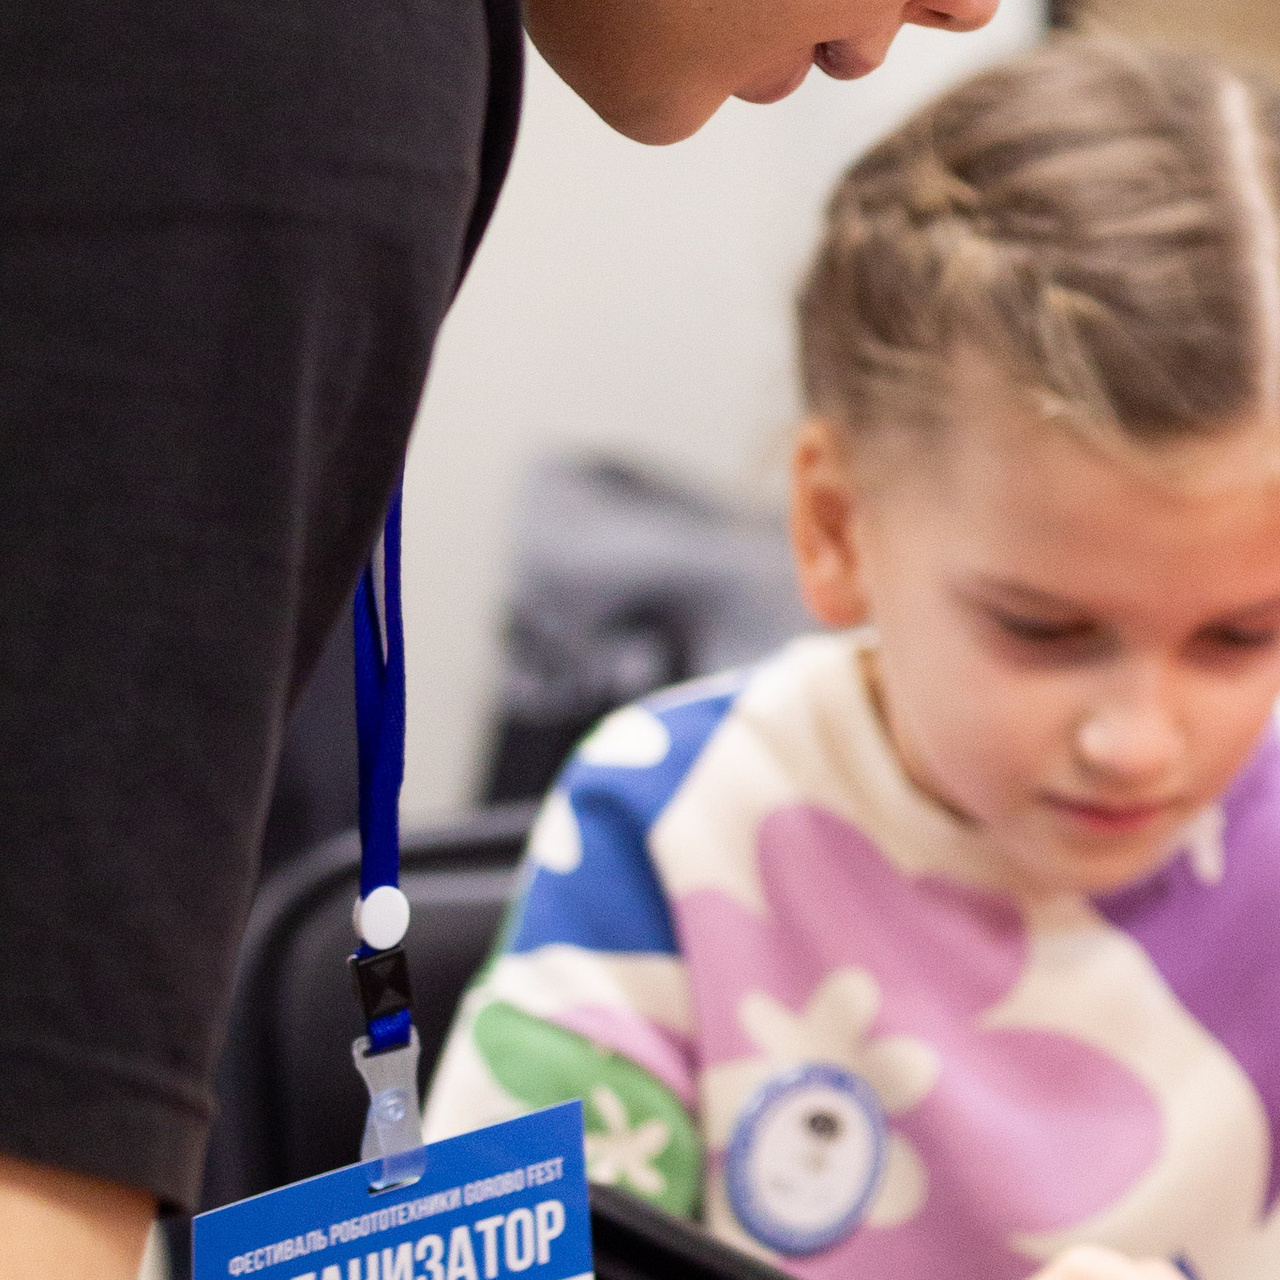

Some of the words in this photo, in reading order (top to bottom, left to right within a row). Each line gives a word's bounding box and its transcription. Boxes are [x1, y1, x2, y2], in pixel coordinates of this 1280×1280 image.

[228, 1228, 329, 1277] ФЕСТИВАЛЬ
[329, 1187, 462, 1247] РОБОТОТЕХНИКИ
[526, 1156, 565, 1188] FEST
